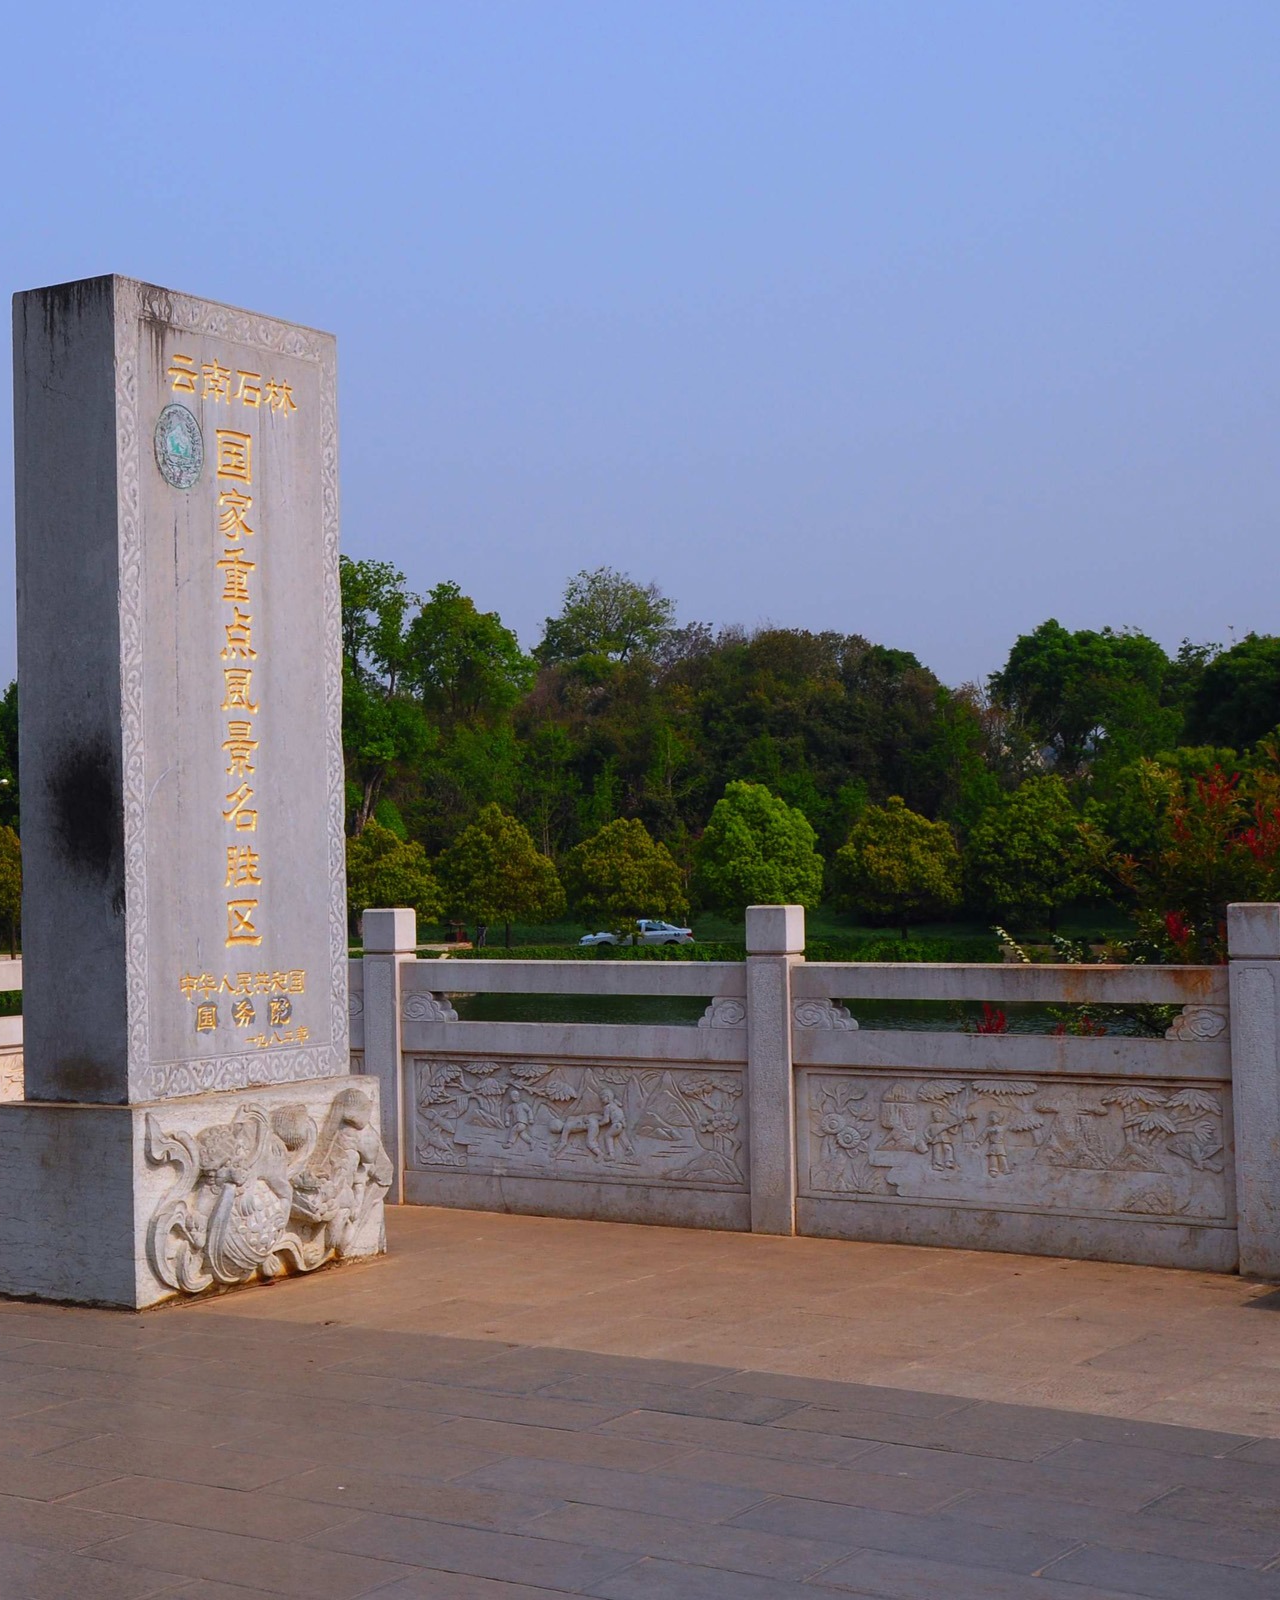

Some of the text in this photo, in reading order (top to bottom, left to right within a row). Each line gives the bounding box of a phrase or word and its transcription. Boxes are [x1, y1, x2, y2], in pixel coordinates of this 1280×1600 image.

[168, 354, 297, 416] 云南石林
[180, 969, 305, 1000] 中华人民共和国
